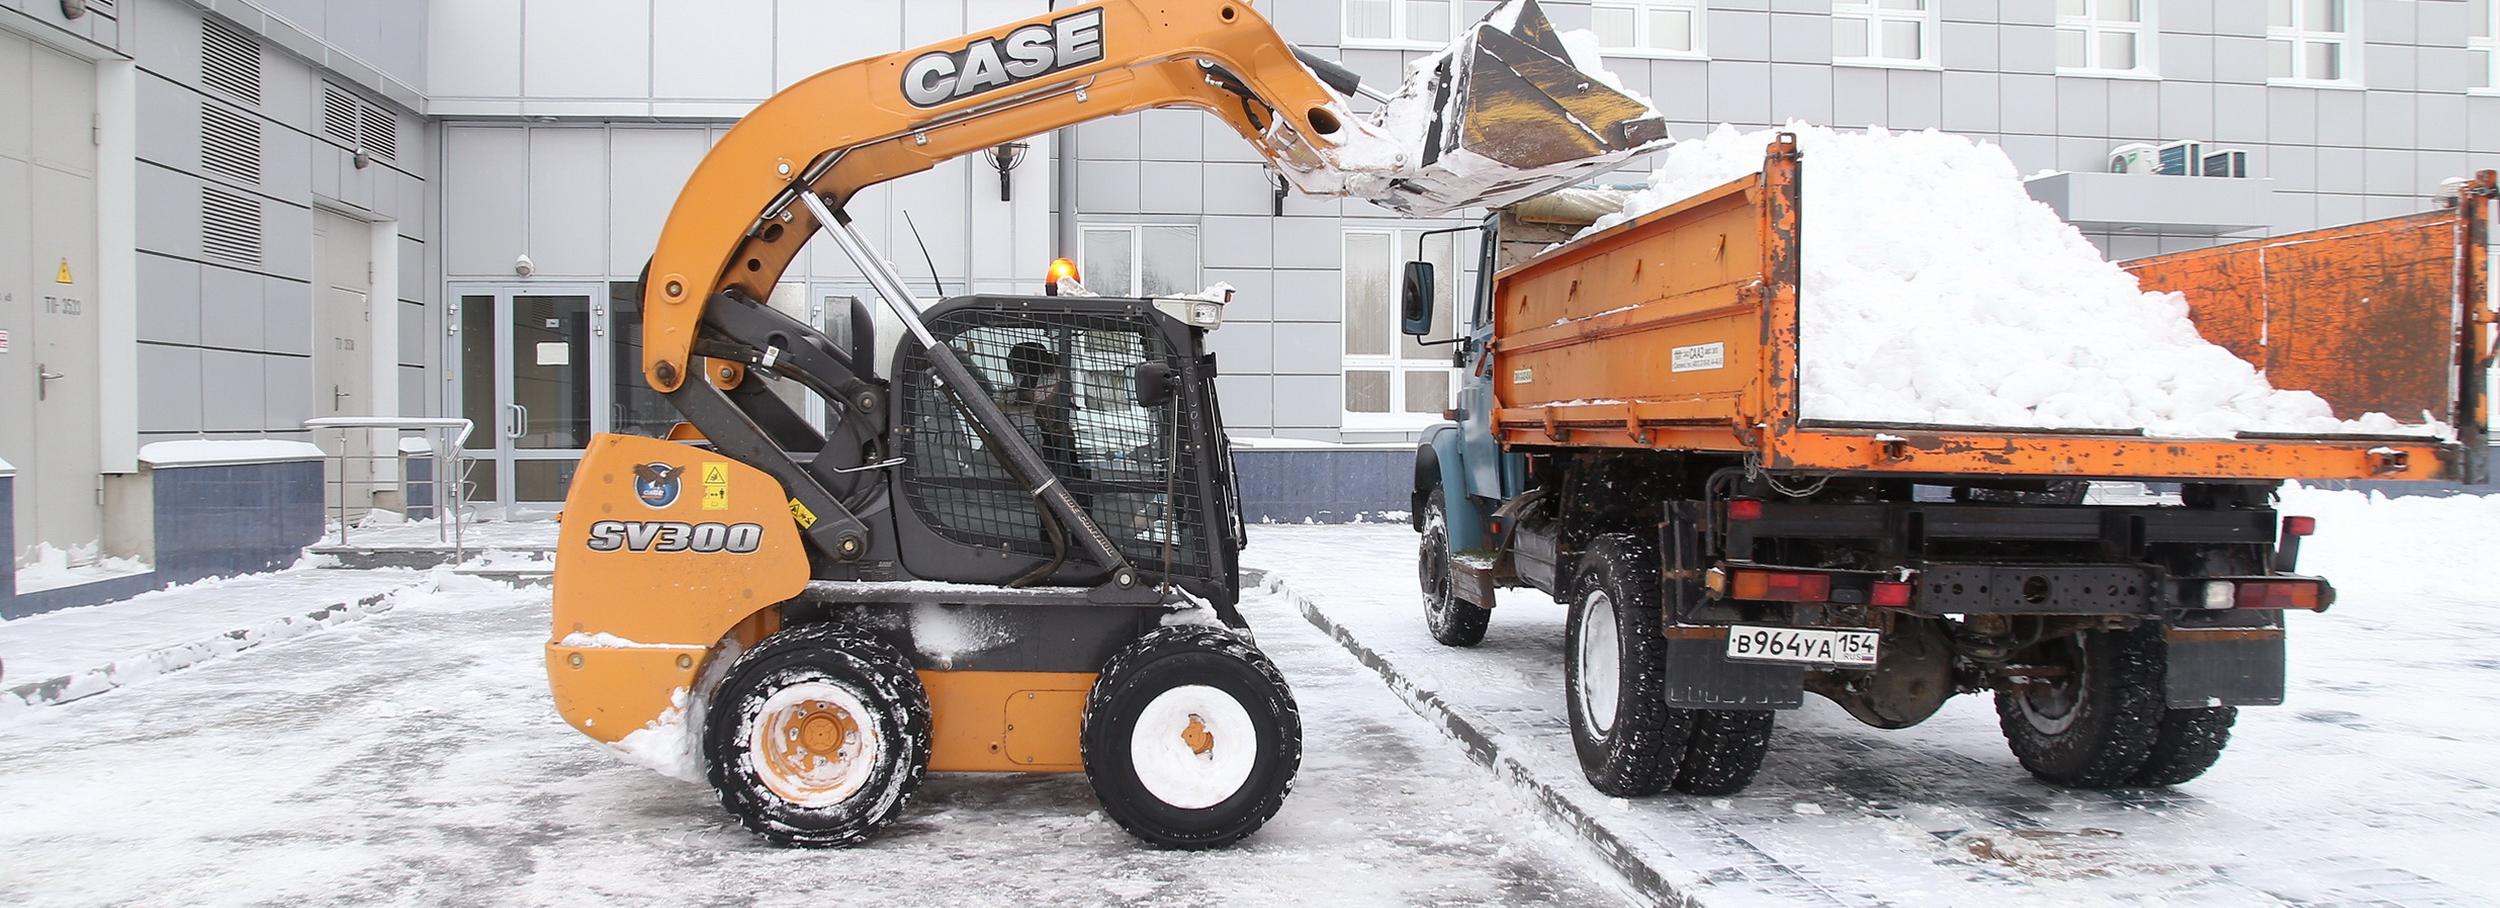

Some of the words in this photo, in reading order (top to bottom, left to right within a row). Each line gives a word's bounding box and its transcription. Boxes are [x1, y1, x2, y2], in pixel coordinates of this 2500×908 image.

[903, 8, 1102, 106] CASE
[588, 520, 763, 553] SV300
[1738, 630, 1831, 658] В964УА
[1838, 634, 1874, 653] 154
